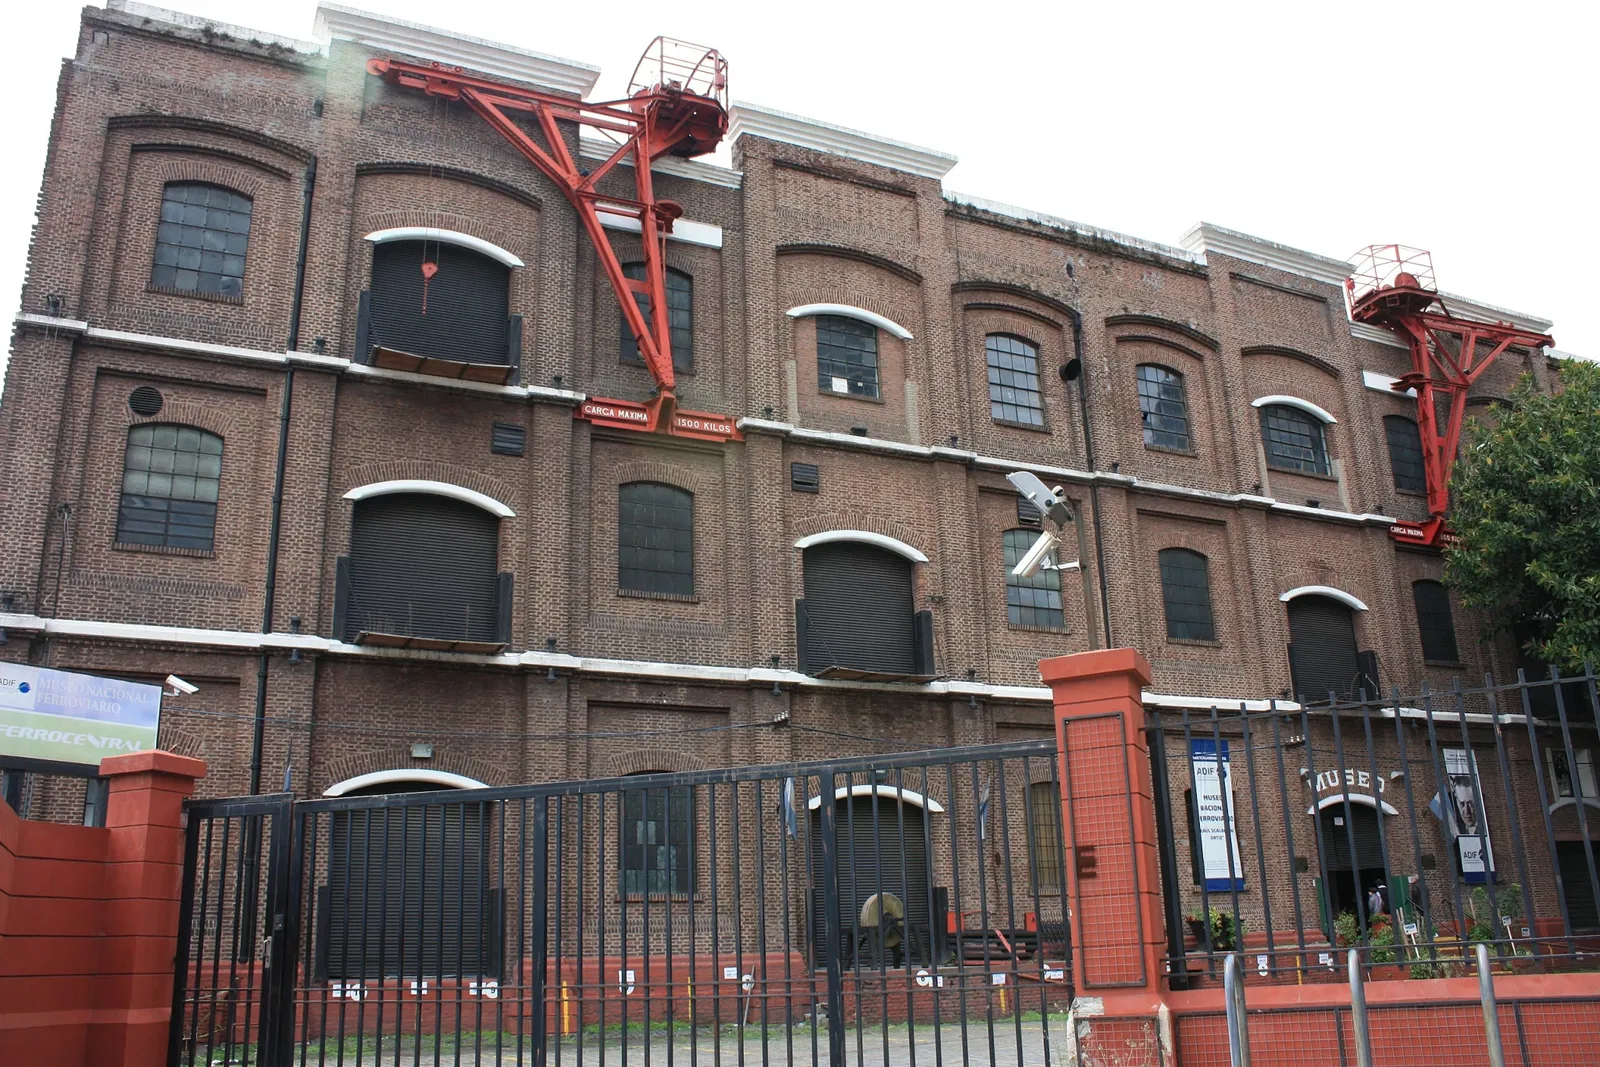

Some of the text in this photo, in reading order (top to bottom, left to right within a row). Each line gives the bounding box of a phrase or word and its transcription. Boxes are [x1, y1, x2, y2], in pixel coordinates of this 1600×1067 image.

[584, 405, 648, 422] CARGA MAXIMA
[677, 418, 731, 433] 1500 KILOS
[38, 678, 86, 696] MUSEO
[87, 685, 149, 704] NACIONAL
[36, 691, 122, 714] FERROVIARIO
[1197, 767, 1215, 776] ADIF
[1463, 851, 1478, 859] ADIF
